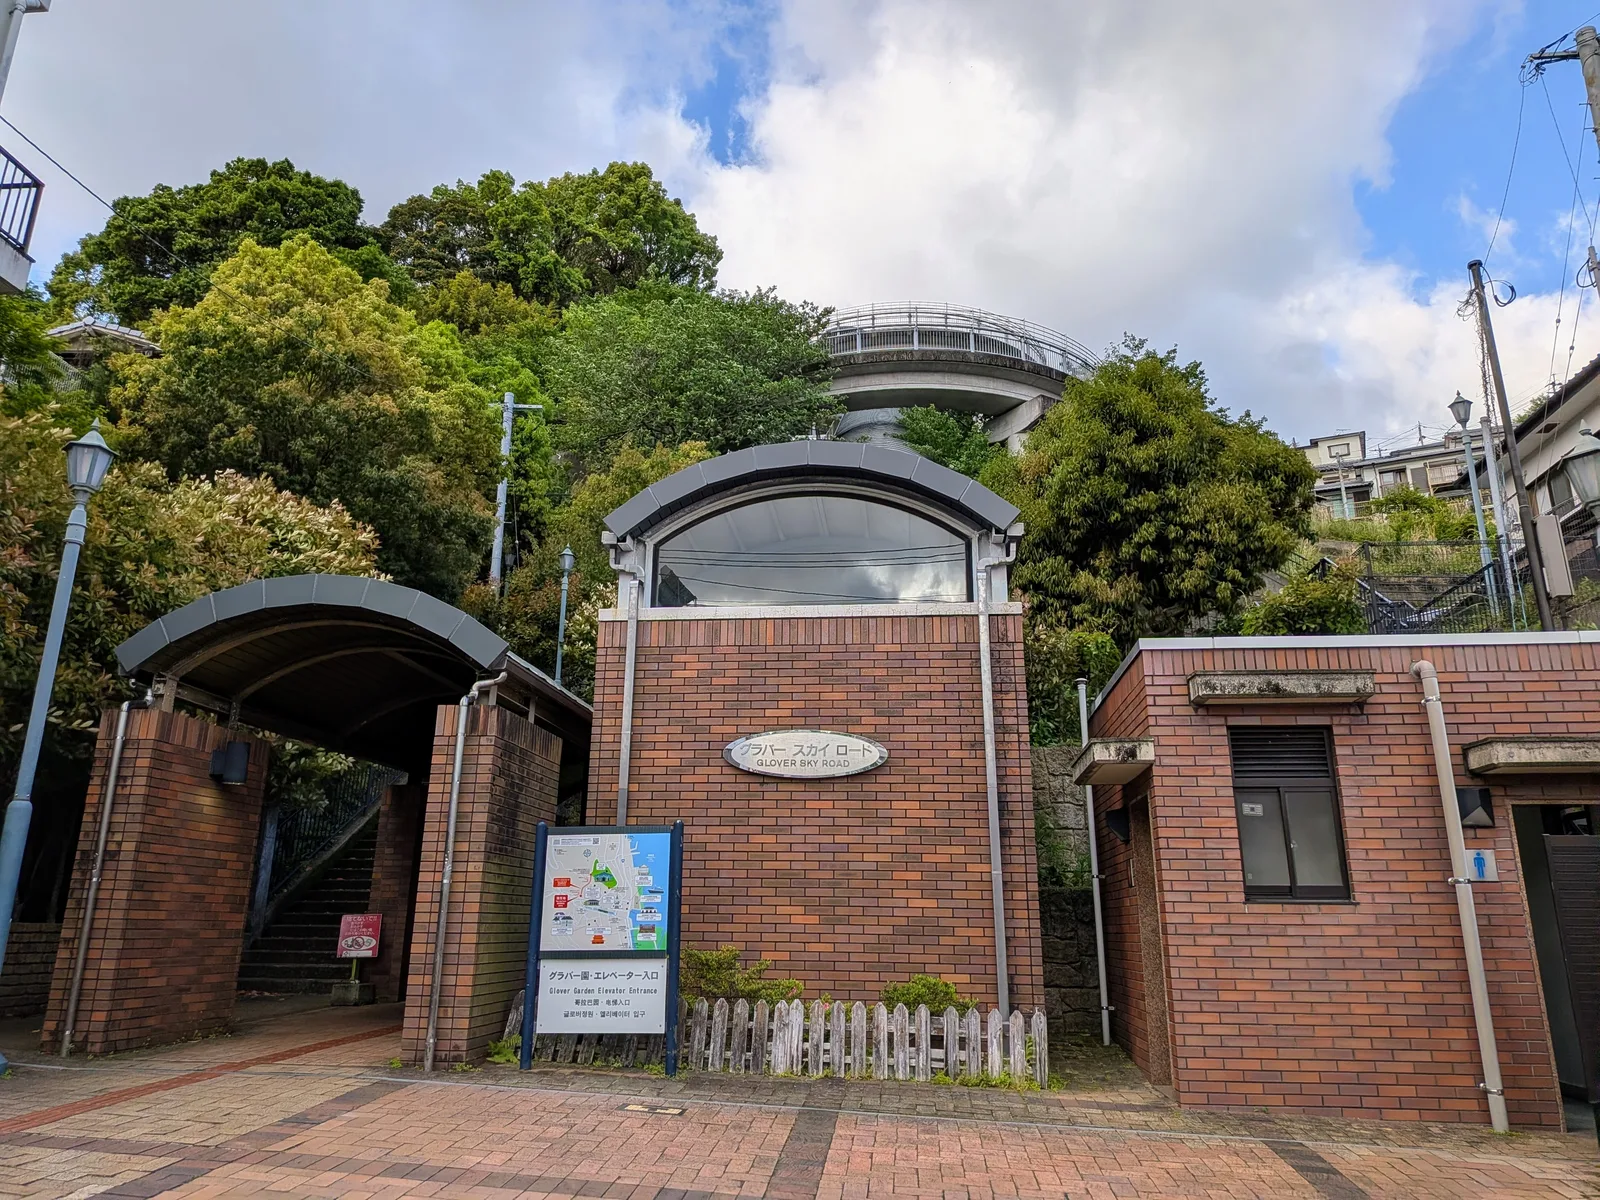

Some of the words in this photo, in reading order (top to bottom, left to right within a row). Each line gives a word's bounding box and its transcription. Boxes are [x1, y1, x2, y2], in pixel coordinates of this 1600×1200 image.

[740, 743, 786, 757] グラバー
[792, 743, 830, 757] スカイ
[836, 743, 872, 758] ロード
[756, 758, 796, 768] GLOVER
[799, 759, 818, 768] SKY
[822, 759, 850, 768] ROAD
[549, 987, 570, 995] Glover
[573, 987, 595, 995] Garden
[597, 987, 626, 995] Elevator
[628, 987, 658, 995] Entrance
